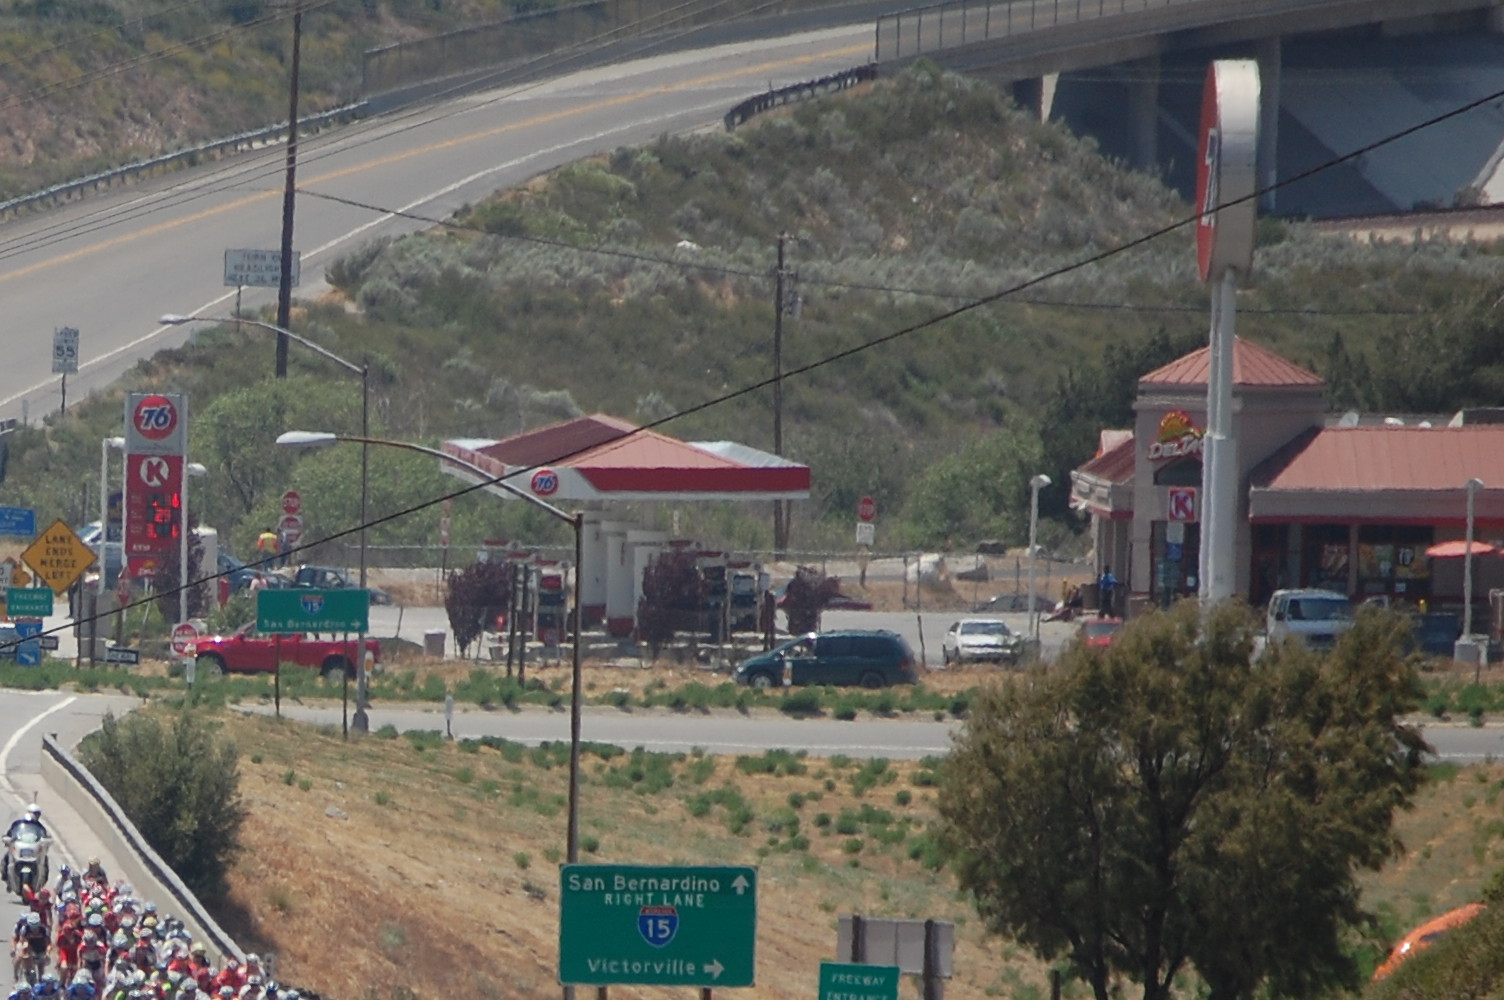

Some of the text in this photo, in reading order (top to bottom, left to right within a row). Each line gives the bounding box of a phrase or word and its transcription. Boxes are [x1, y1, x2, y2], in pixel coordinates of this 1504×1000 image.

[141, 406, 170, 430] 76
[144, 458, 169, 487] K
[535, 474, 555, 492] 76
[1173, 493, 1194, 519] K
[45, 535, 72, 545] LANE
[46, 547, 73, 556] ENDS
[40, 559, 76, 568] MERGE
[46, 570, 72, 579] LEFT
[569, 874, 721, 892] San Bernardino
[604, 893, 705, 907] RIGHT LANE
[647, 918, 671, 938] 15
[588, 958, 696, 975] Victorville
[831, 973, 887, 987] FREEWAY
